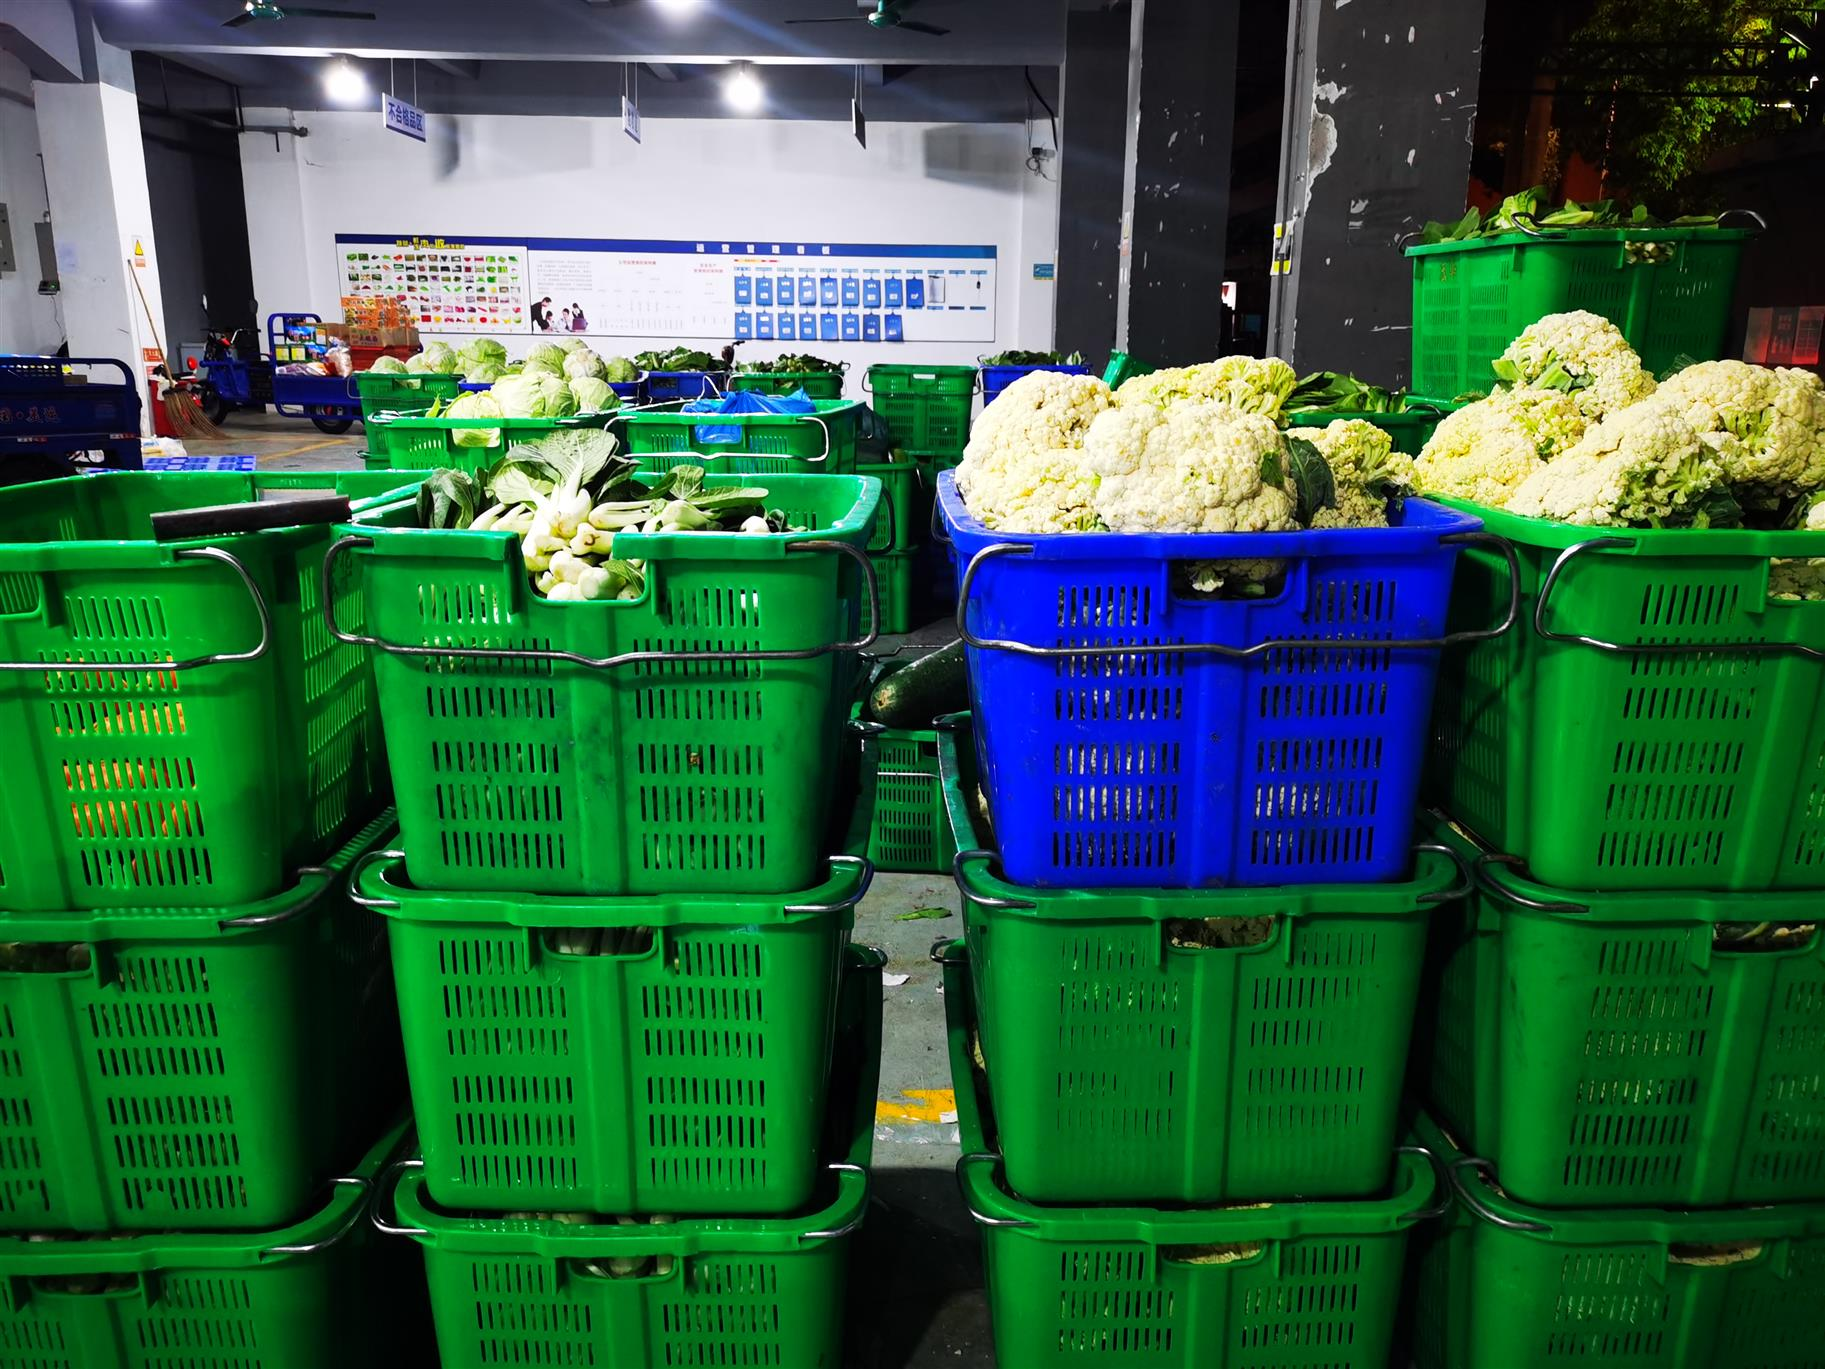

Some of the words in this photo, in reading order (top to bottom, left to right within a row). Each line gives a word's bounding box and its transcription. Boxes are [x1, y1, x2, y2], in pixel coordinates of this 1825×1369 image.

[388, 102, 423, 131] 不合格品区
